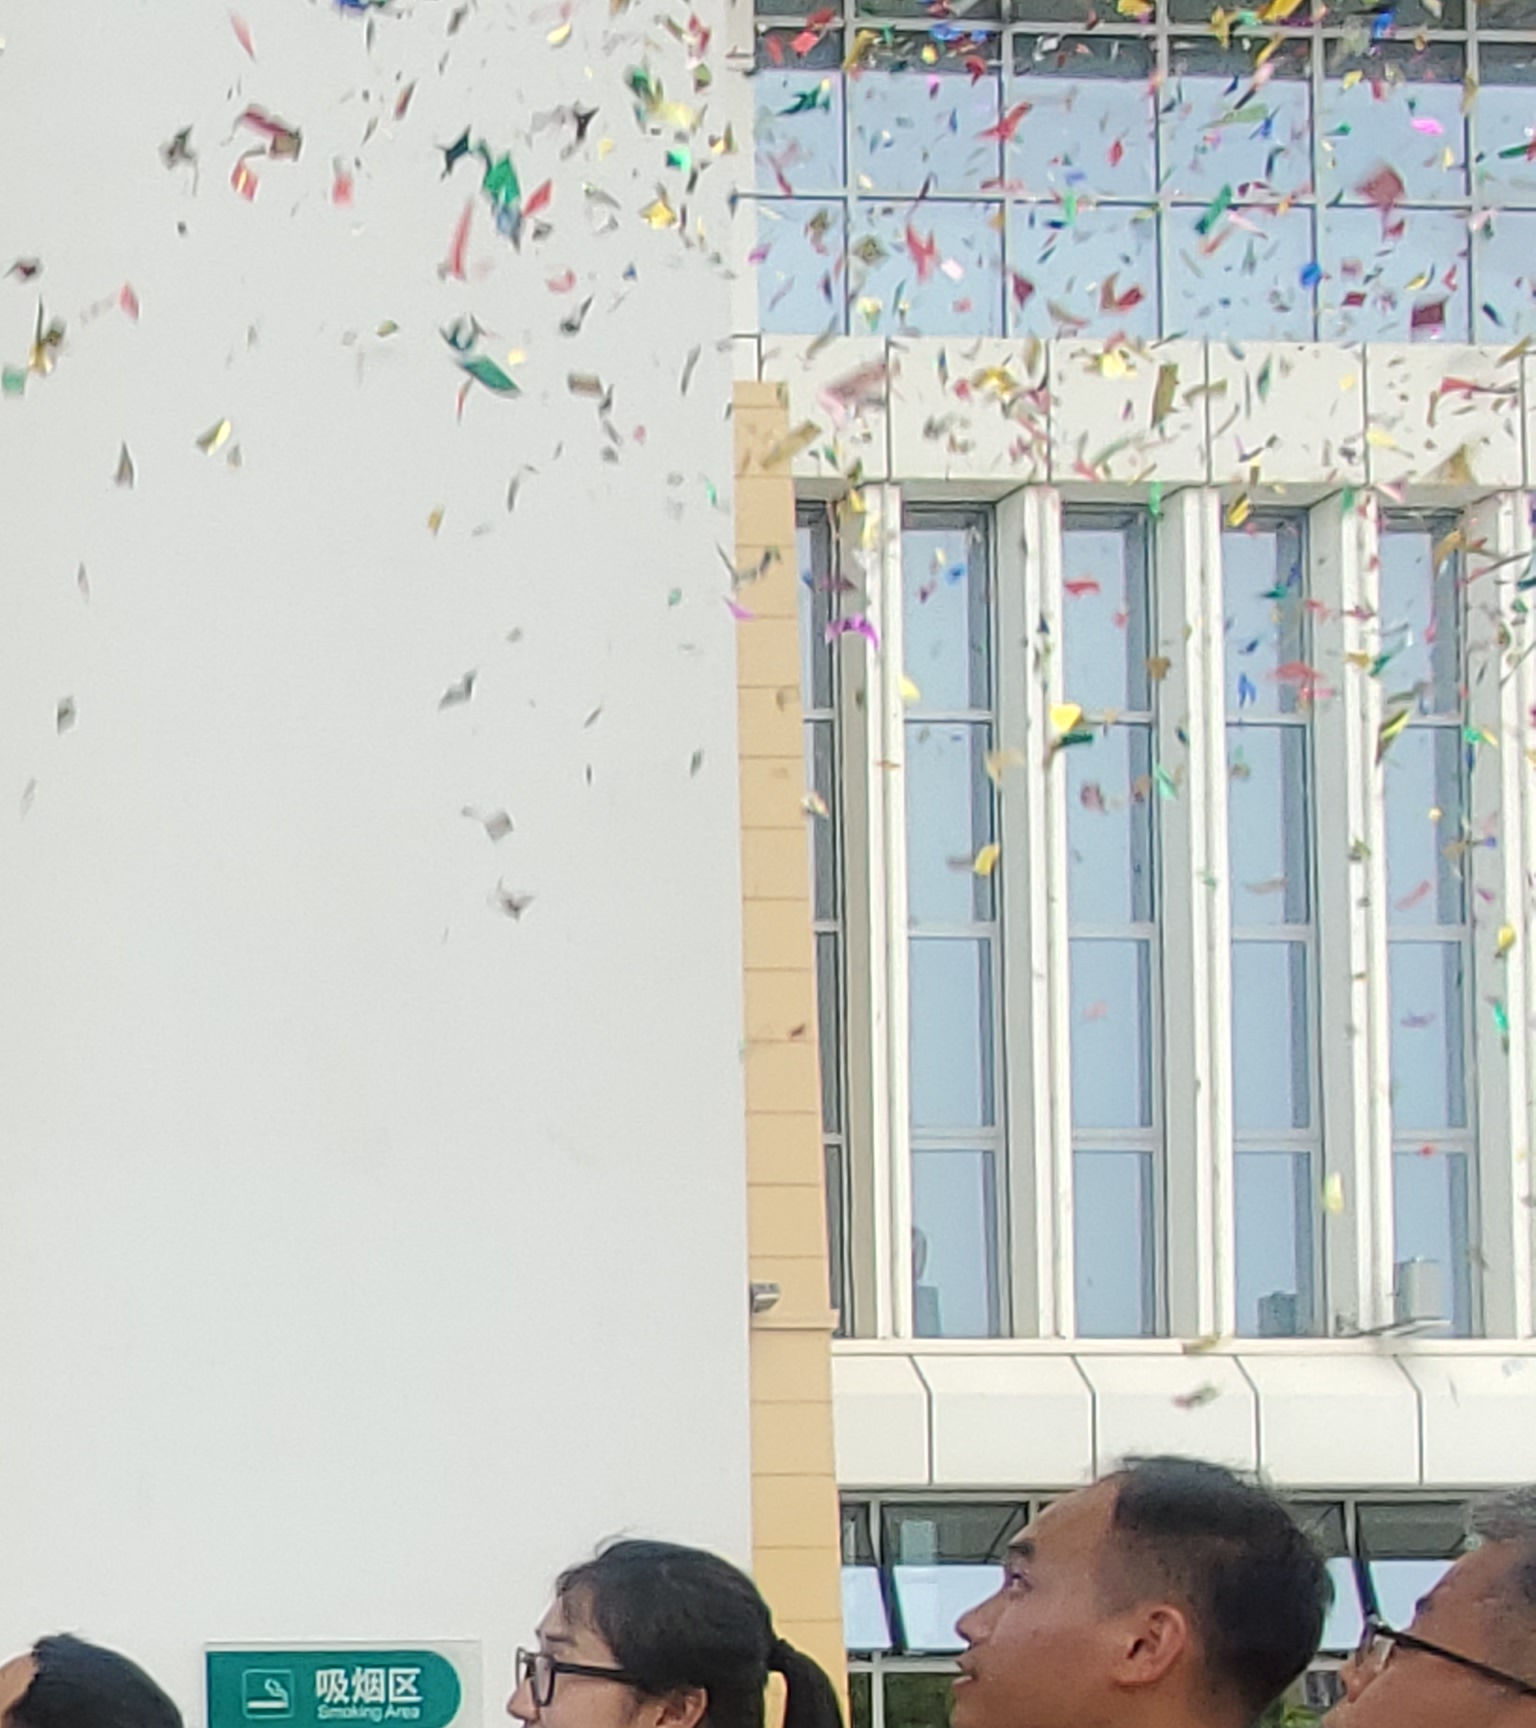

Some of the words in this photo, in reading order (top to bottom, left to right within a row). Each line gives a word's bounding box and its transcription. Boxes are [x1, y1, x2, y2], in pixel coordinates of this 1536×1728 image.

[315, 1667, 424, 1704] 吸烟区
[317, 1704, 382, 1722] Smoking
[384, 1704, 420, 1719] Area
